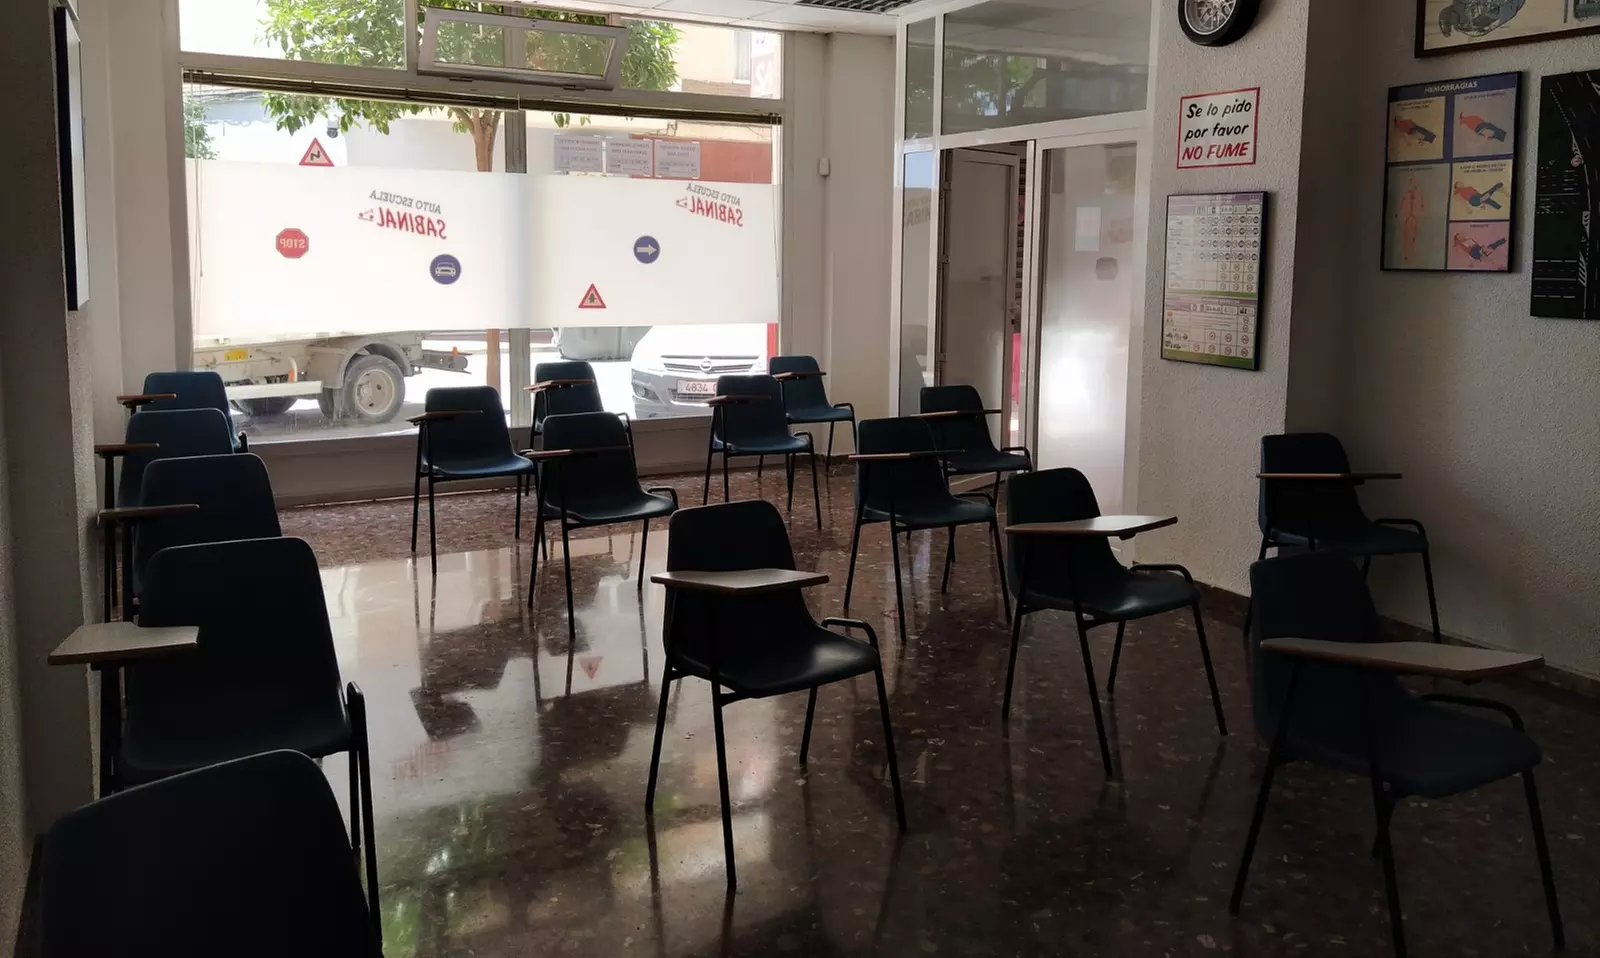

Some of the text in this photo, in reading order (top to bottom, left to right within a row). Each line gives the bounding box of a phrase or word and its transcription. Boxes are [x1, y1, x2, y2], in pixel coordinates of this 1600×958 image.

[1424, 81, 1479, 94] HEMORRAGIAS
[1186, 98, 1252, 118] Se lo pido
[1184, 123, 1249, 142] por favor
[1182, 142, 1250, 160] NO FUME
[685, 382, 708, 393] 4834
